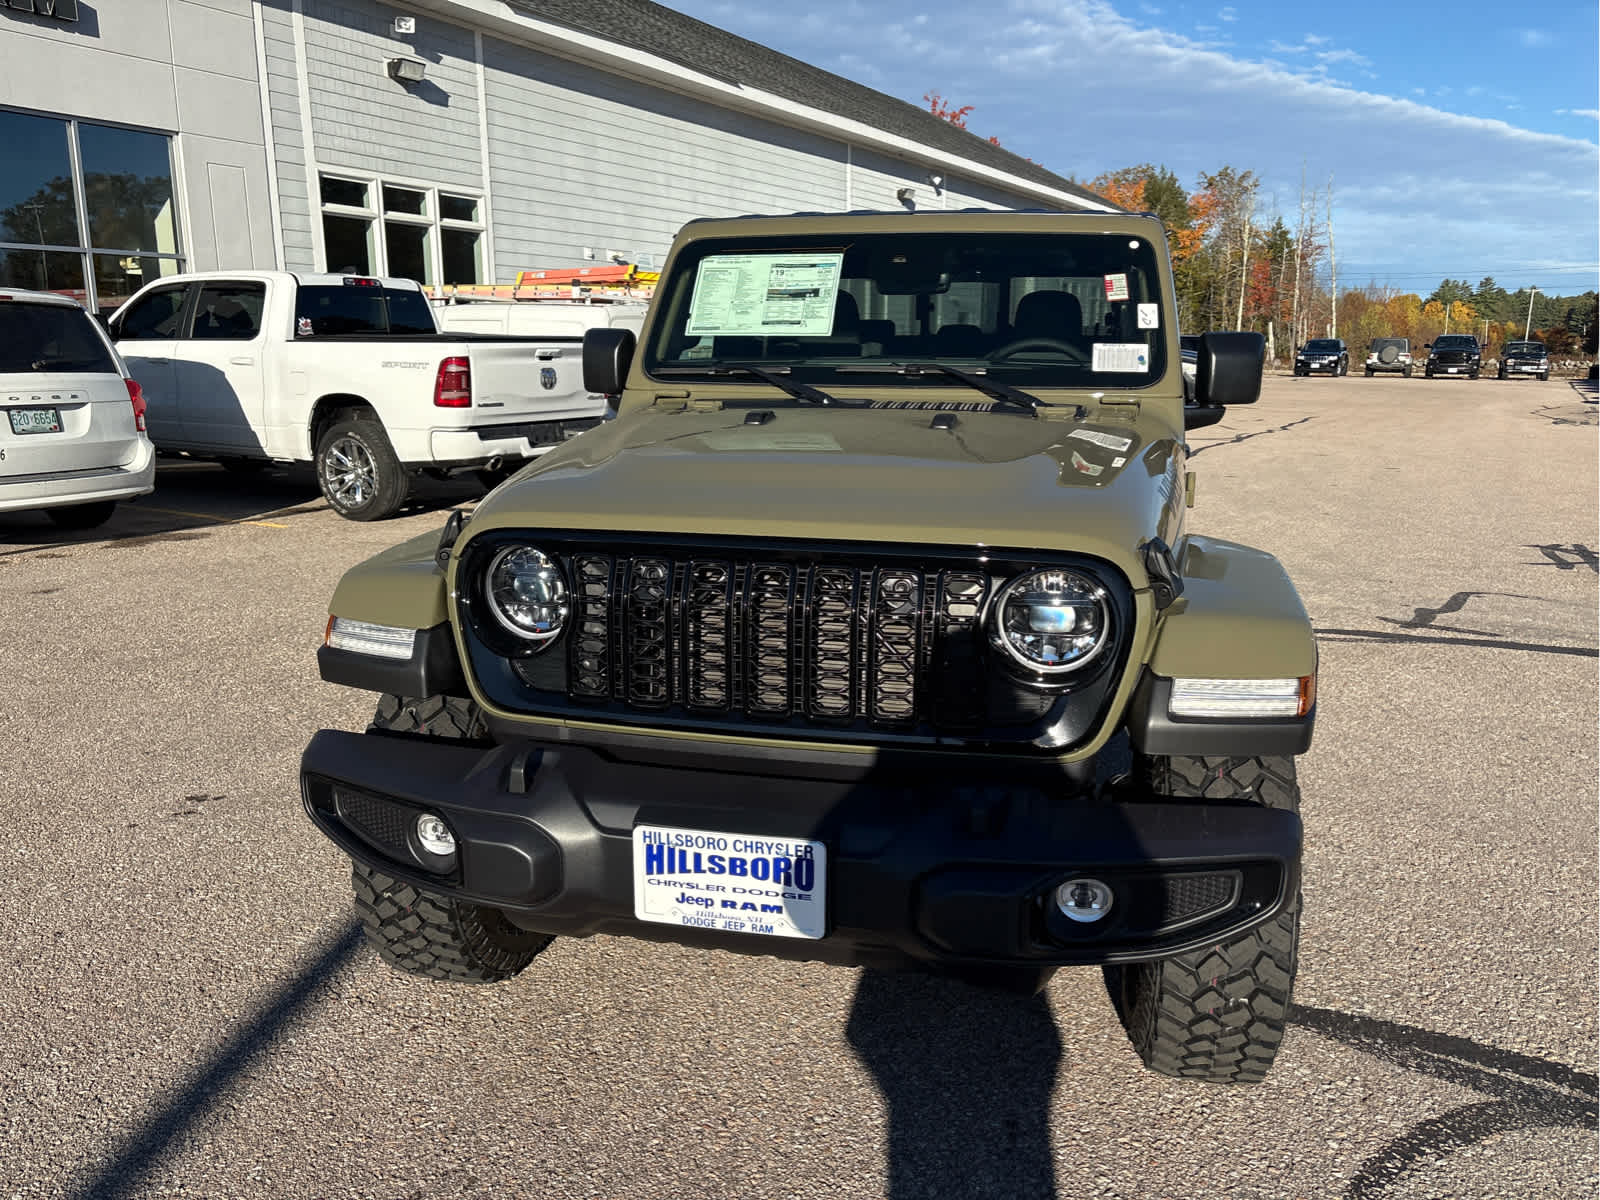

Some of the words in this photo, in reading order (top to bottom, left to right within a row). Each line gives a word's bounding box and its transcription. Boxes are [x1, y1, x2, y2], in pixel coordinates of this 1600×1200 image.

[381, 361, 430, 369] SPORT
[642, 830, 728, 851] HILLSBORO
[733, 839, 814, 859] CHRYSLER
[645, 844, 815, 892] HILLSBORO
[647, 878, 726, 893] CHRYSLER
[732, 887, 812, 901] DODGE
[675, 892, 714, 909] Jeep
[721, 899, 783, 915] RAM
[682, 915, 717, 928] DODGE
[722, 919, 746, 931] JEEP
[751, 924, 774, 934] RAM
